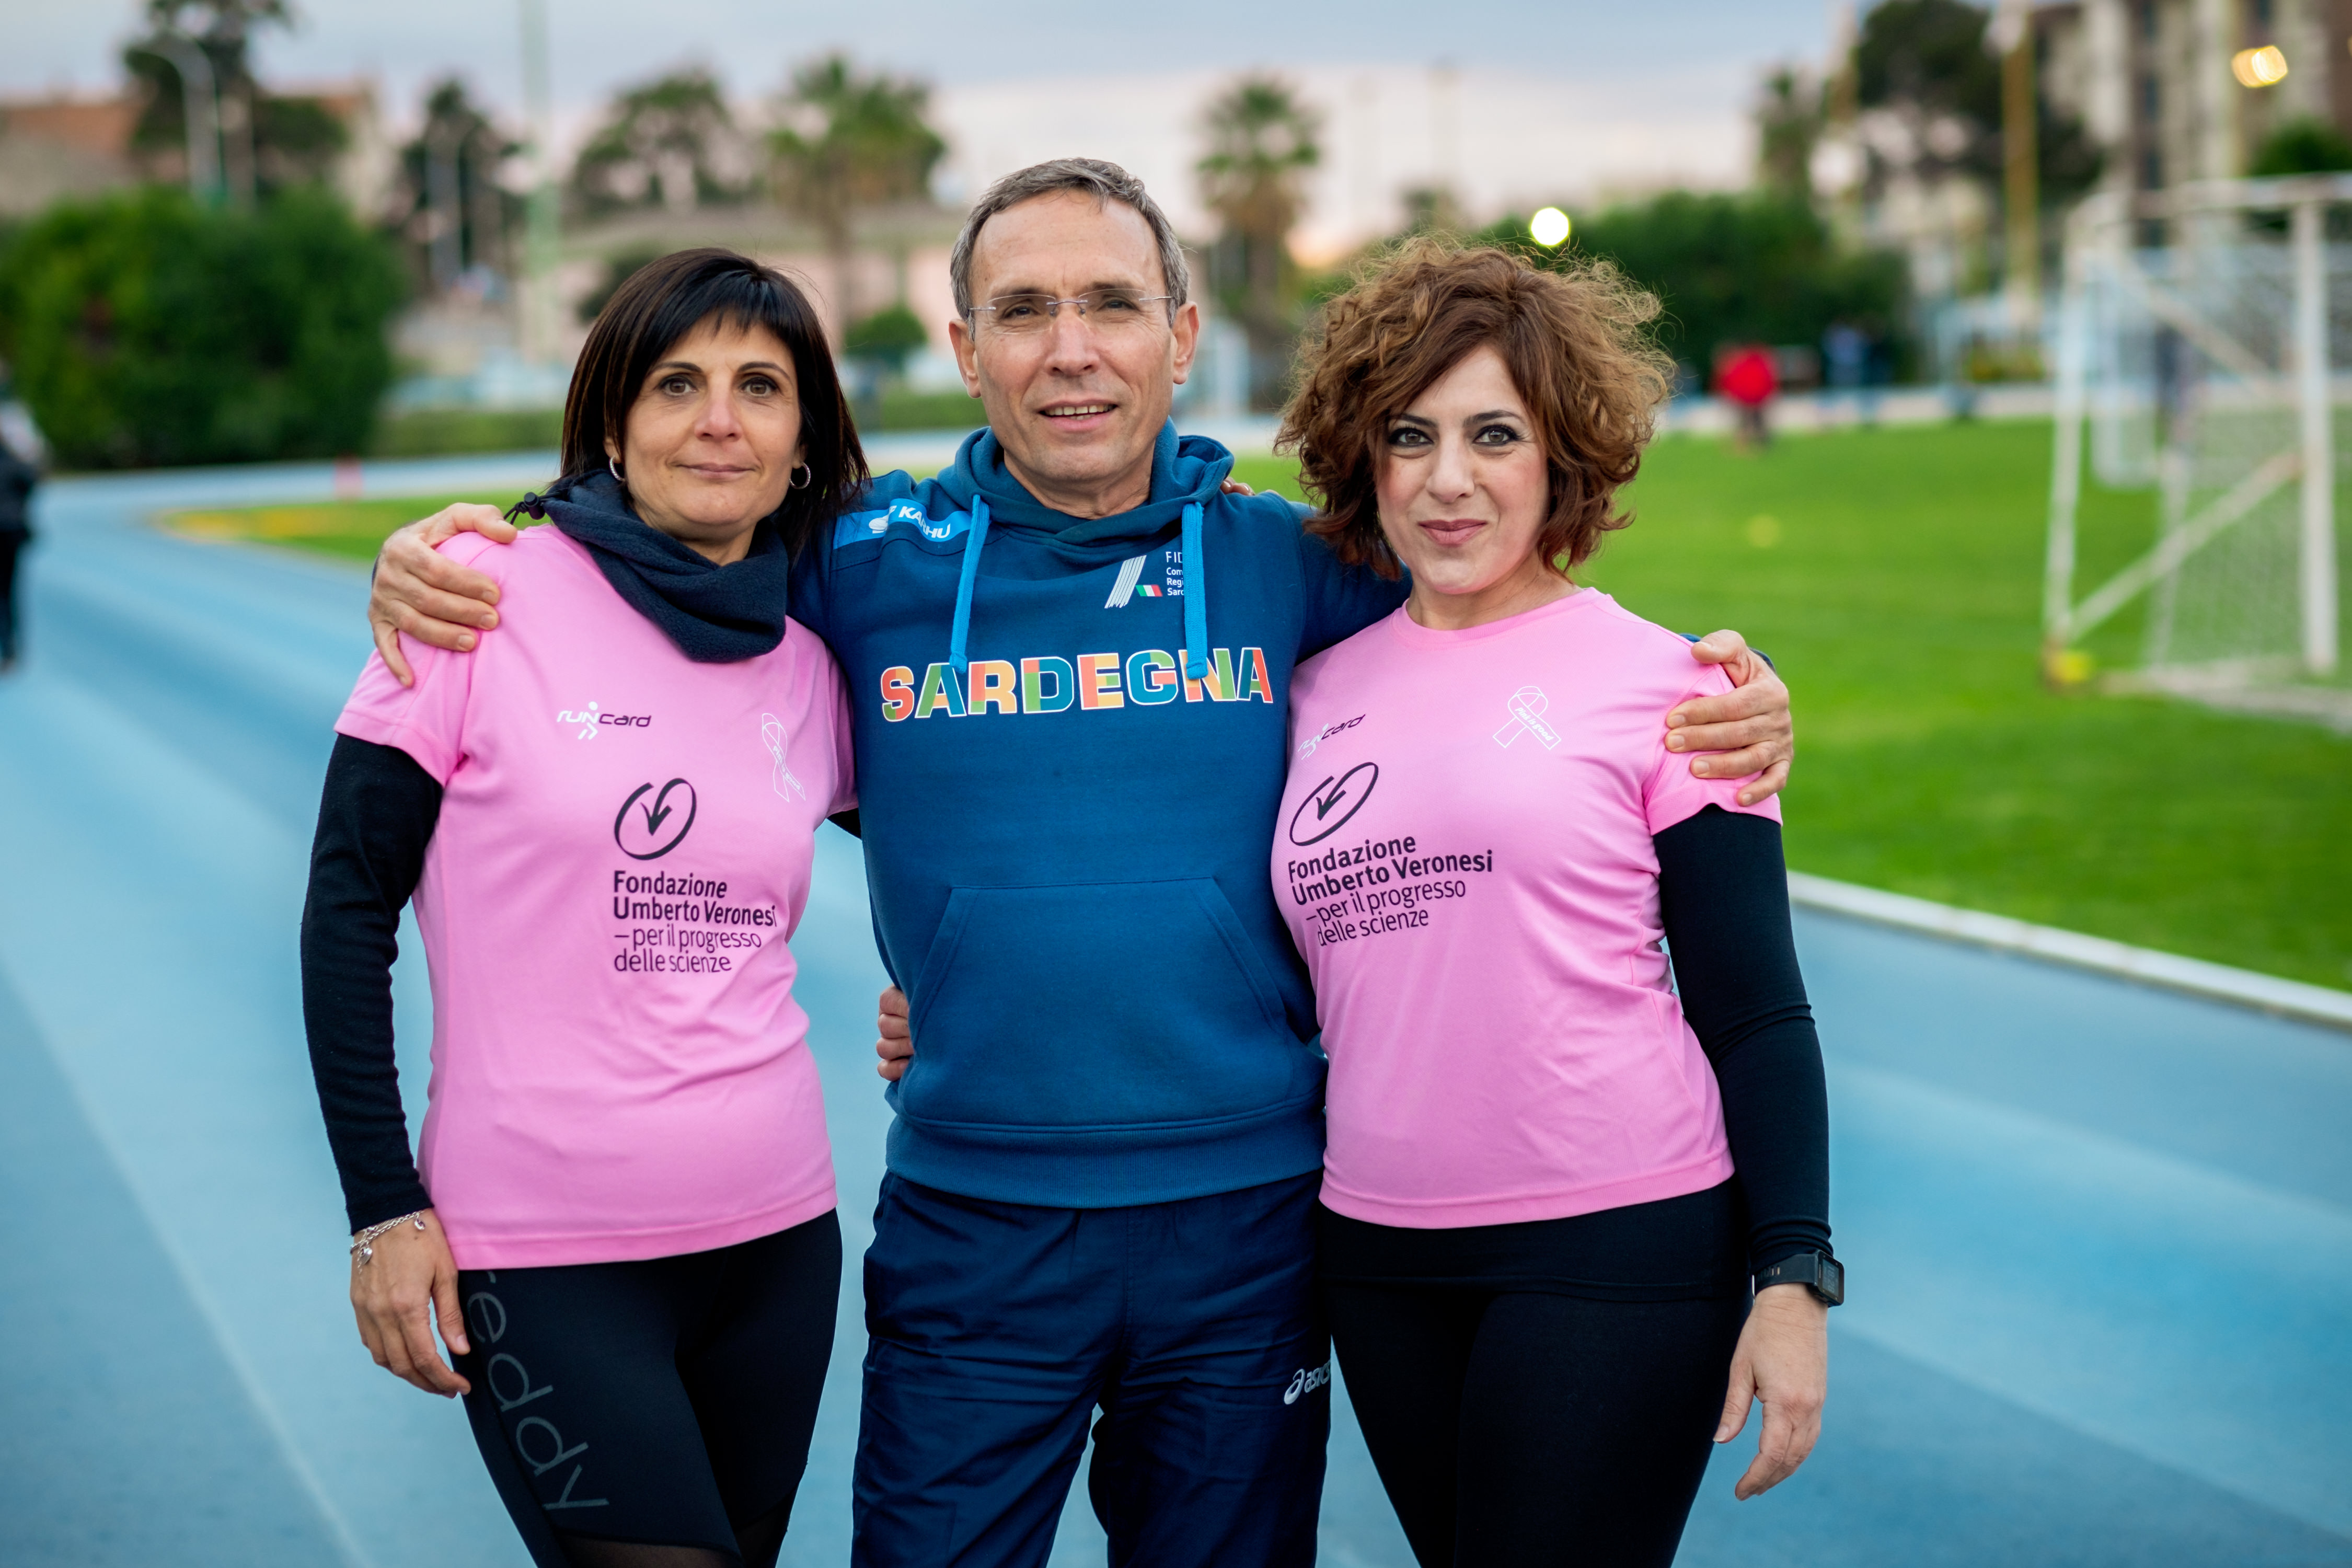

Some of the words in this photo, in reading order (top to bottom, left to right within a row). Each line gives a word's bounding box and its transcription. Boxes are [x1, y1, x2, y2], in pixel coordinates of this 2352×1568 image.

[898, 506, 950, 538] KARHU
[1166, 551, 1183, 563] FID
[1166, 567, 1183, 575] Com
[1167, 578, 1184, 587] Regi
[881, 647, 1273, 722] SARDEGNA
[1515, 707, 1531, 721] Pink
[1531, 724, 1554, 741] good
[1288, 836, 1416, 883] Fondazione
[614, 870, 727, 898] Fondazione
[1292, 865, 1390, 905] Umberto
[1391, 849, 1493, 879] Veronesi
[614, 896, 700, 922] Umberto
[705, 900, 777, 927] Veronesi
[1350, 891, 1365, 913] il
[1366, 880, 1466, 916] progresso
[667, 923, 675, 947] il
[679, 929, 762, 953] progresso
[1318, 921, 1357, 947] delle
[1359, 909, 1428, 937] scienze
[614, 948, 665, 972] delle
[670, 950, 732, 973] scienze
[467, 1270, 609, 1510] eddy
